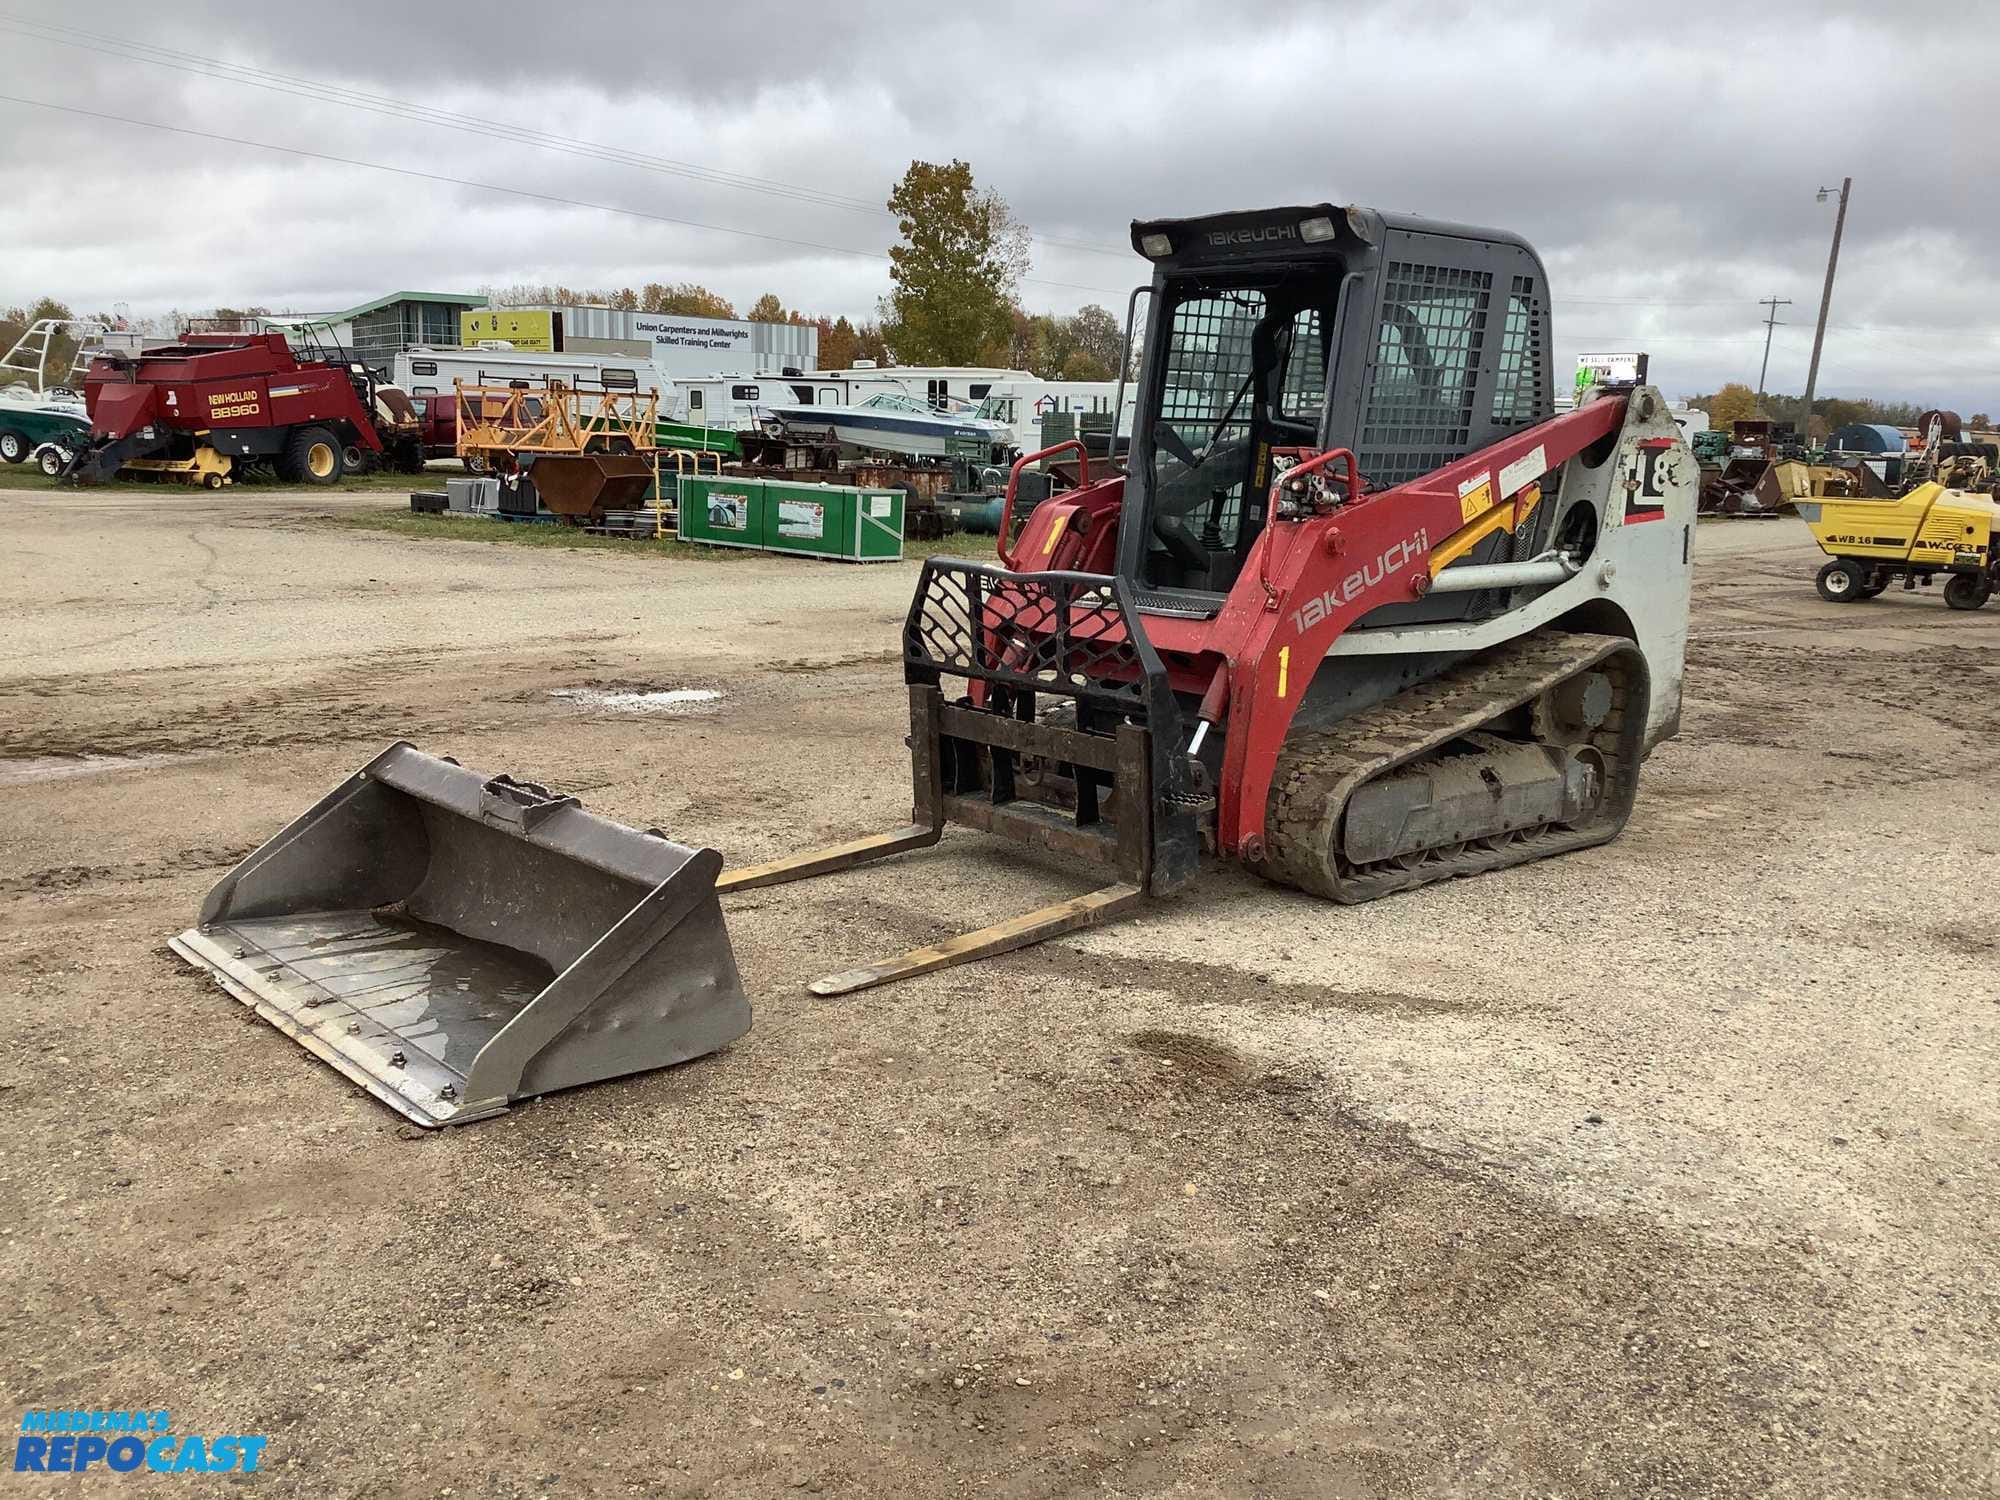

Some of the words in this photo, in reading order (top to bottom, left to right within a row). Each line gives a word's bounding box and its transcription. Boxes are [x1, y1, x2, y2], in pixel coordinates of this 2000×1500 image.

[1204, 225, 1297, 246] TAKEUCHI
[636, 322, 658, 332] Union
[659, 324, 697, 335] Carpenters
[697, 328, 711, 336] and
[711, 328, 749, 340] Millwrights
[656, 335, 680, 345] Skilled
[681, 337, 708, 349] Training
[709, 339, 731, 349] Center
[208, 394, 225, 406] NEW
[225, 390, 258, 404] HOLLAND
[211, 403, 260, 419] BB960
[1839, 535, 1856, 544] WB
[1857, 536, 1871, 545] 16
[1288, 527, 1429, 635] TAKEUCHI
